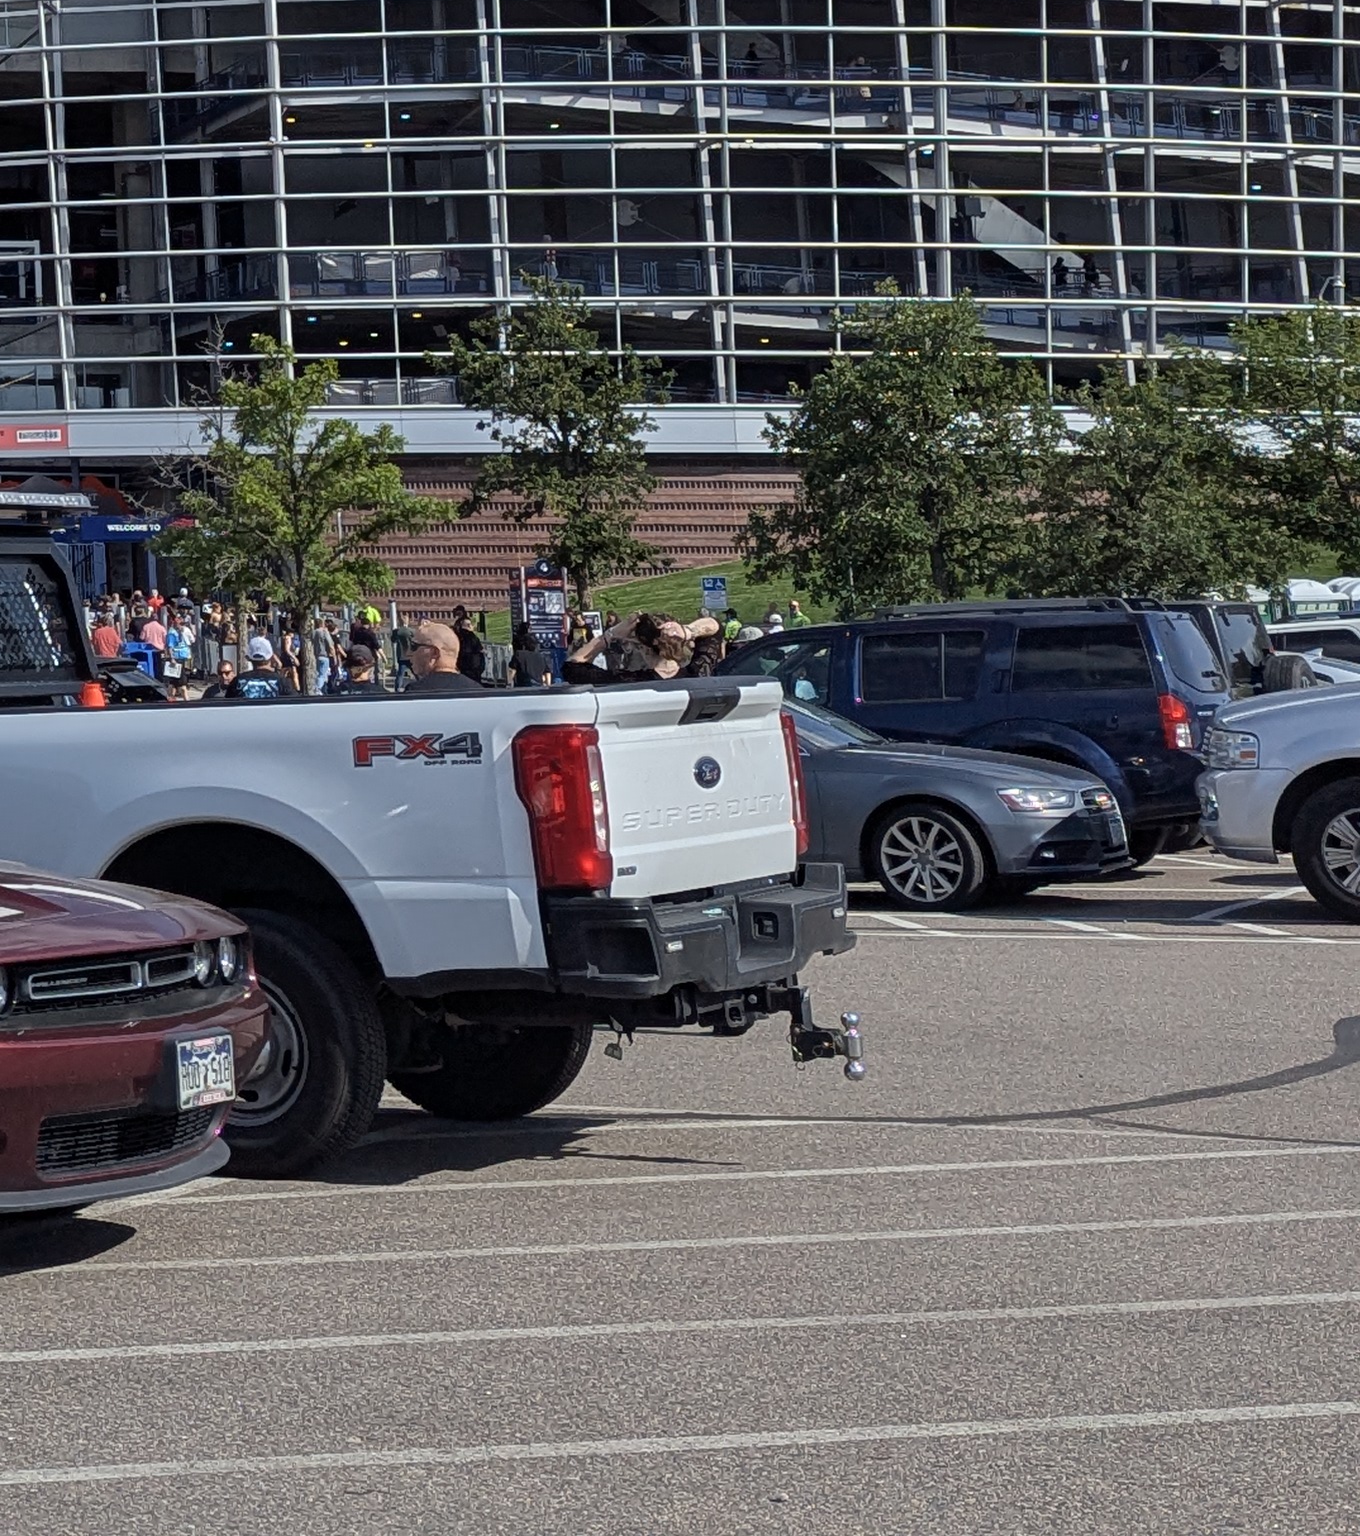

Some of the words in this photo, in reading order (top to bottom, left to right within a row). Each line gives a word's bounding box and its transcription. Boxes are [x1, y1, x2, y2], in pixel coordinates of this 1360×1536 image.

[107, 524, 148, 532] WELCOME
[149, 524, 161, 532] TO
[352, 732, 483, 768] FX4
[622, 802, 721, 832] SUPER
[726, 793, 786, 818] DUTY
